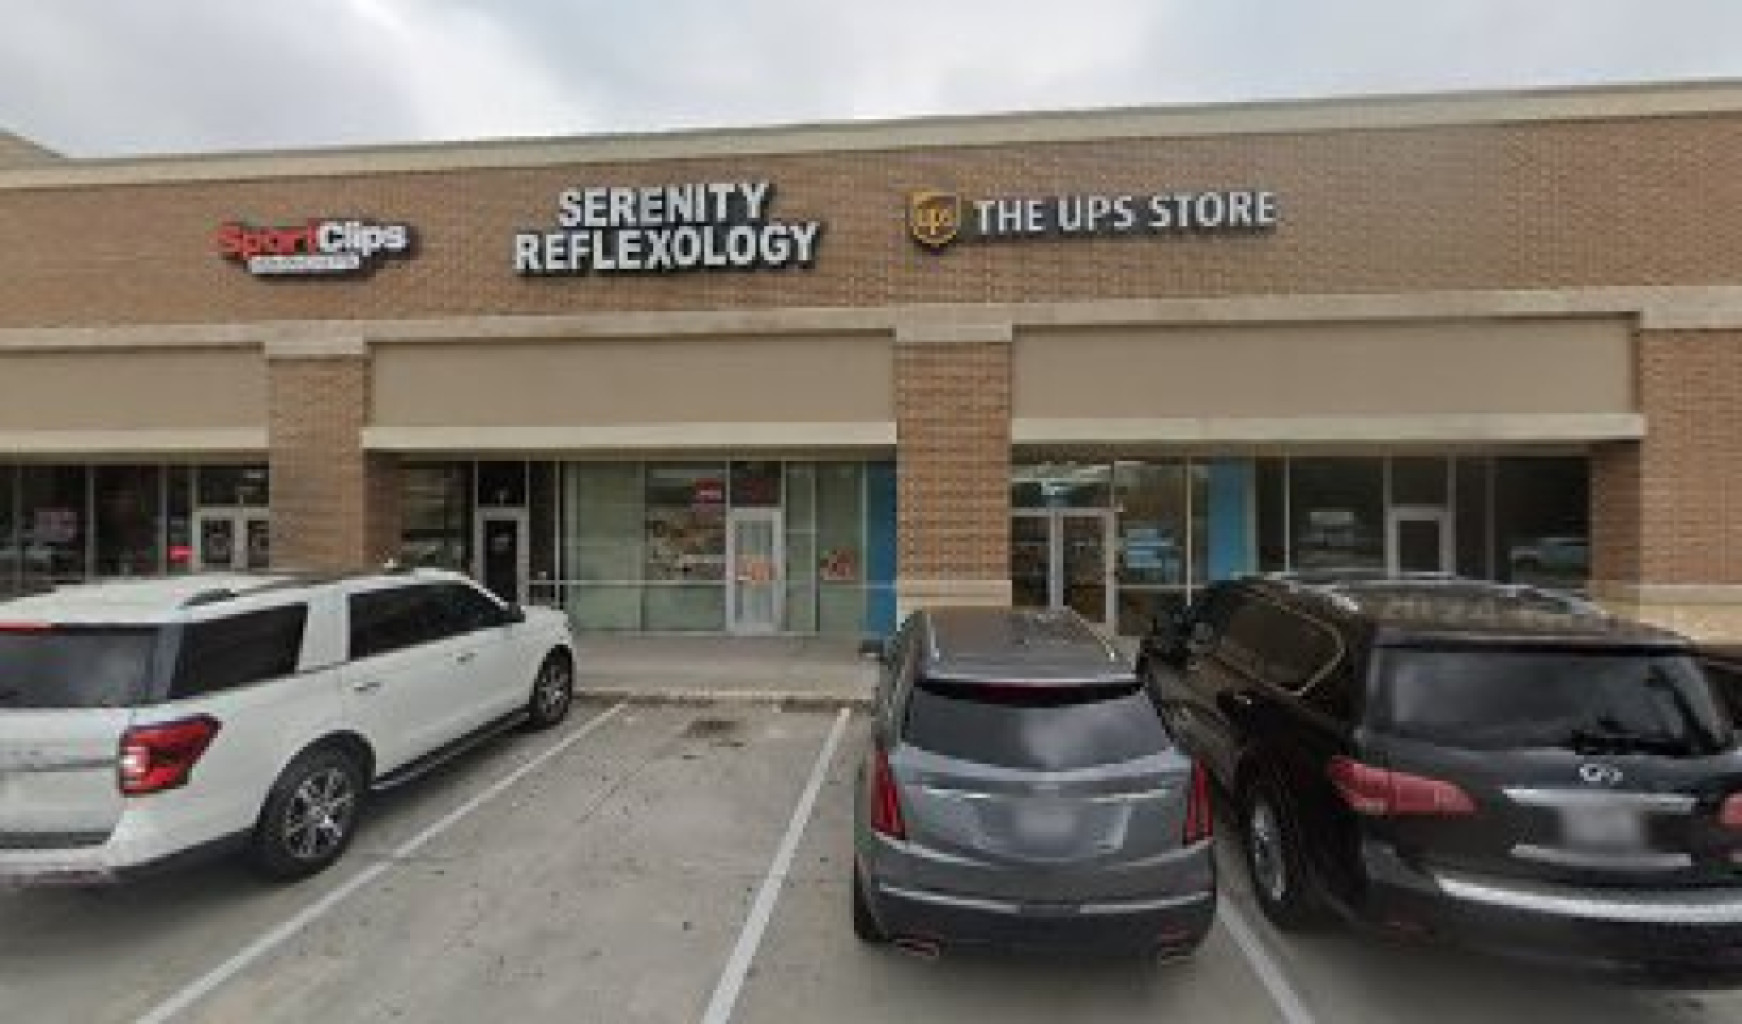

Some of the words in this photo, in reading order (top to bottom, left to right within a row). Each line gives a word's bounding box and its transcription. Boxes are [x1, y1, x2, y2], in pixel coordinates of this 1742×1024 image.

[559, 181, 769, 227] SERENITY
[974, 200, 1046, 231] THE
[1058, 195, 1132, 231] UPS
[1148, 191, 1276, 227] STORE
[515, 221, 819, 270] REFLEXOLOGY
